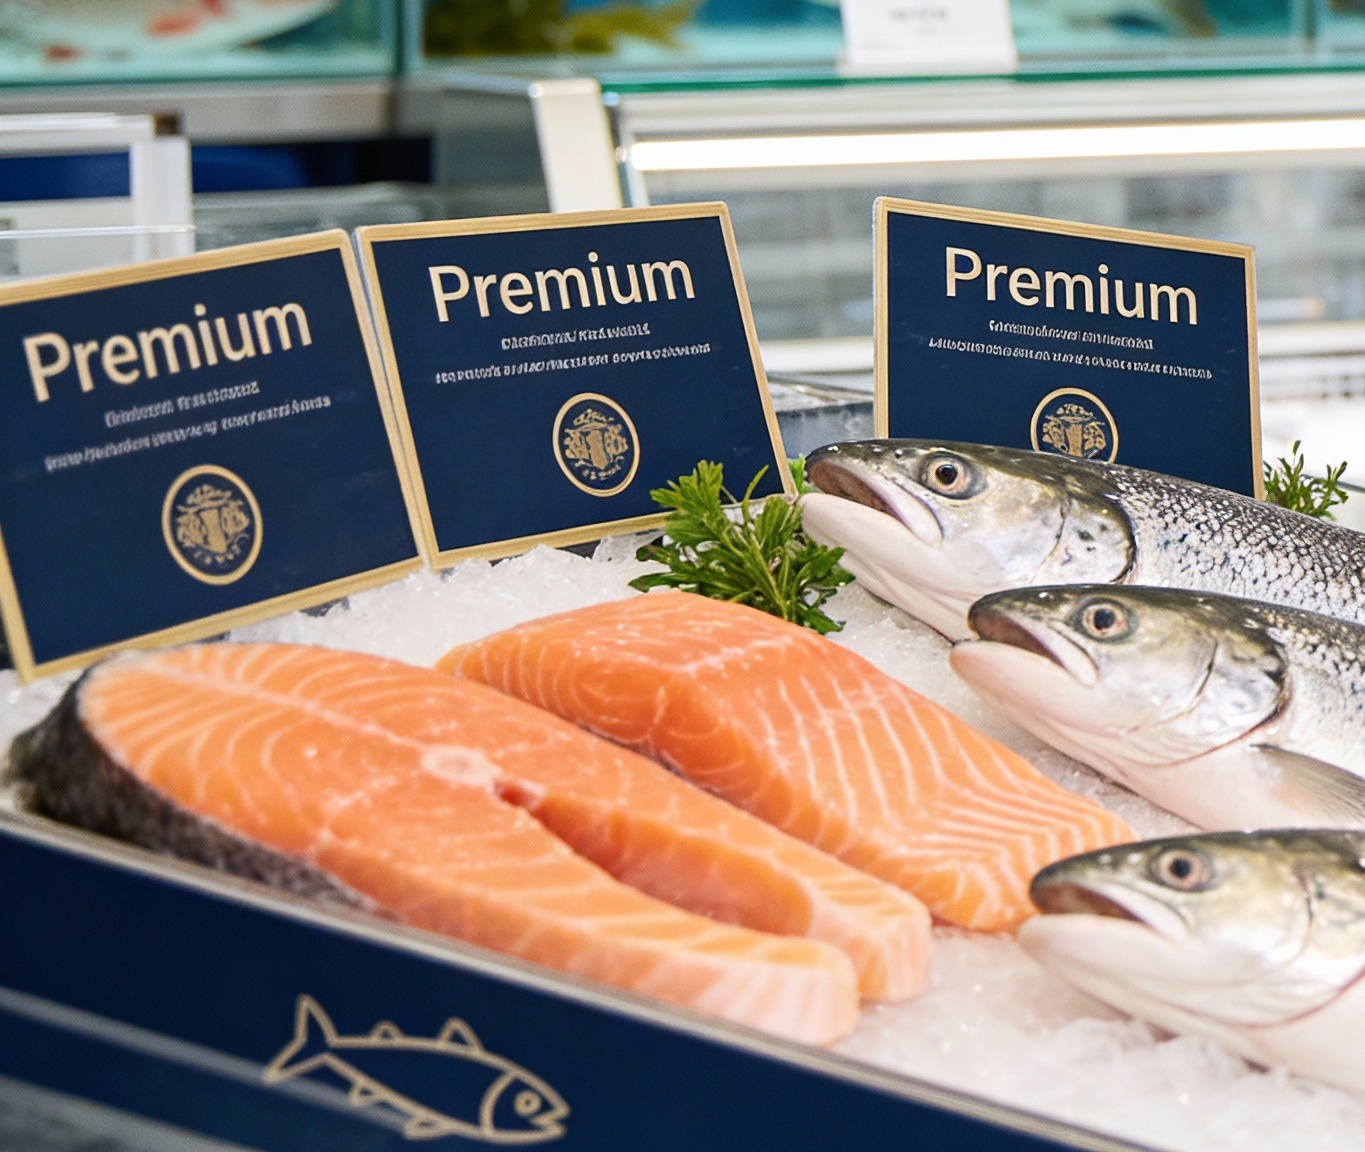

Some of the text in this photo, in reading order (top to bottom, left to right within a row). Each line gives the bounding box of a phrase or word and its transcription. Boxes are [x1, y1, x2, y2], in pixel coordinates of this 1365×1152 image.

[428, 251, 696, 322] Premium
[946, 246, 1198, 325] Premium
[23, 301, 312, 402] Premium
